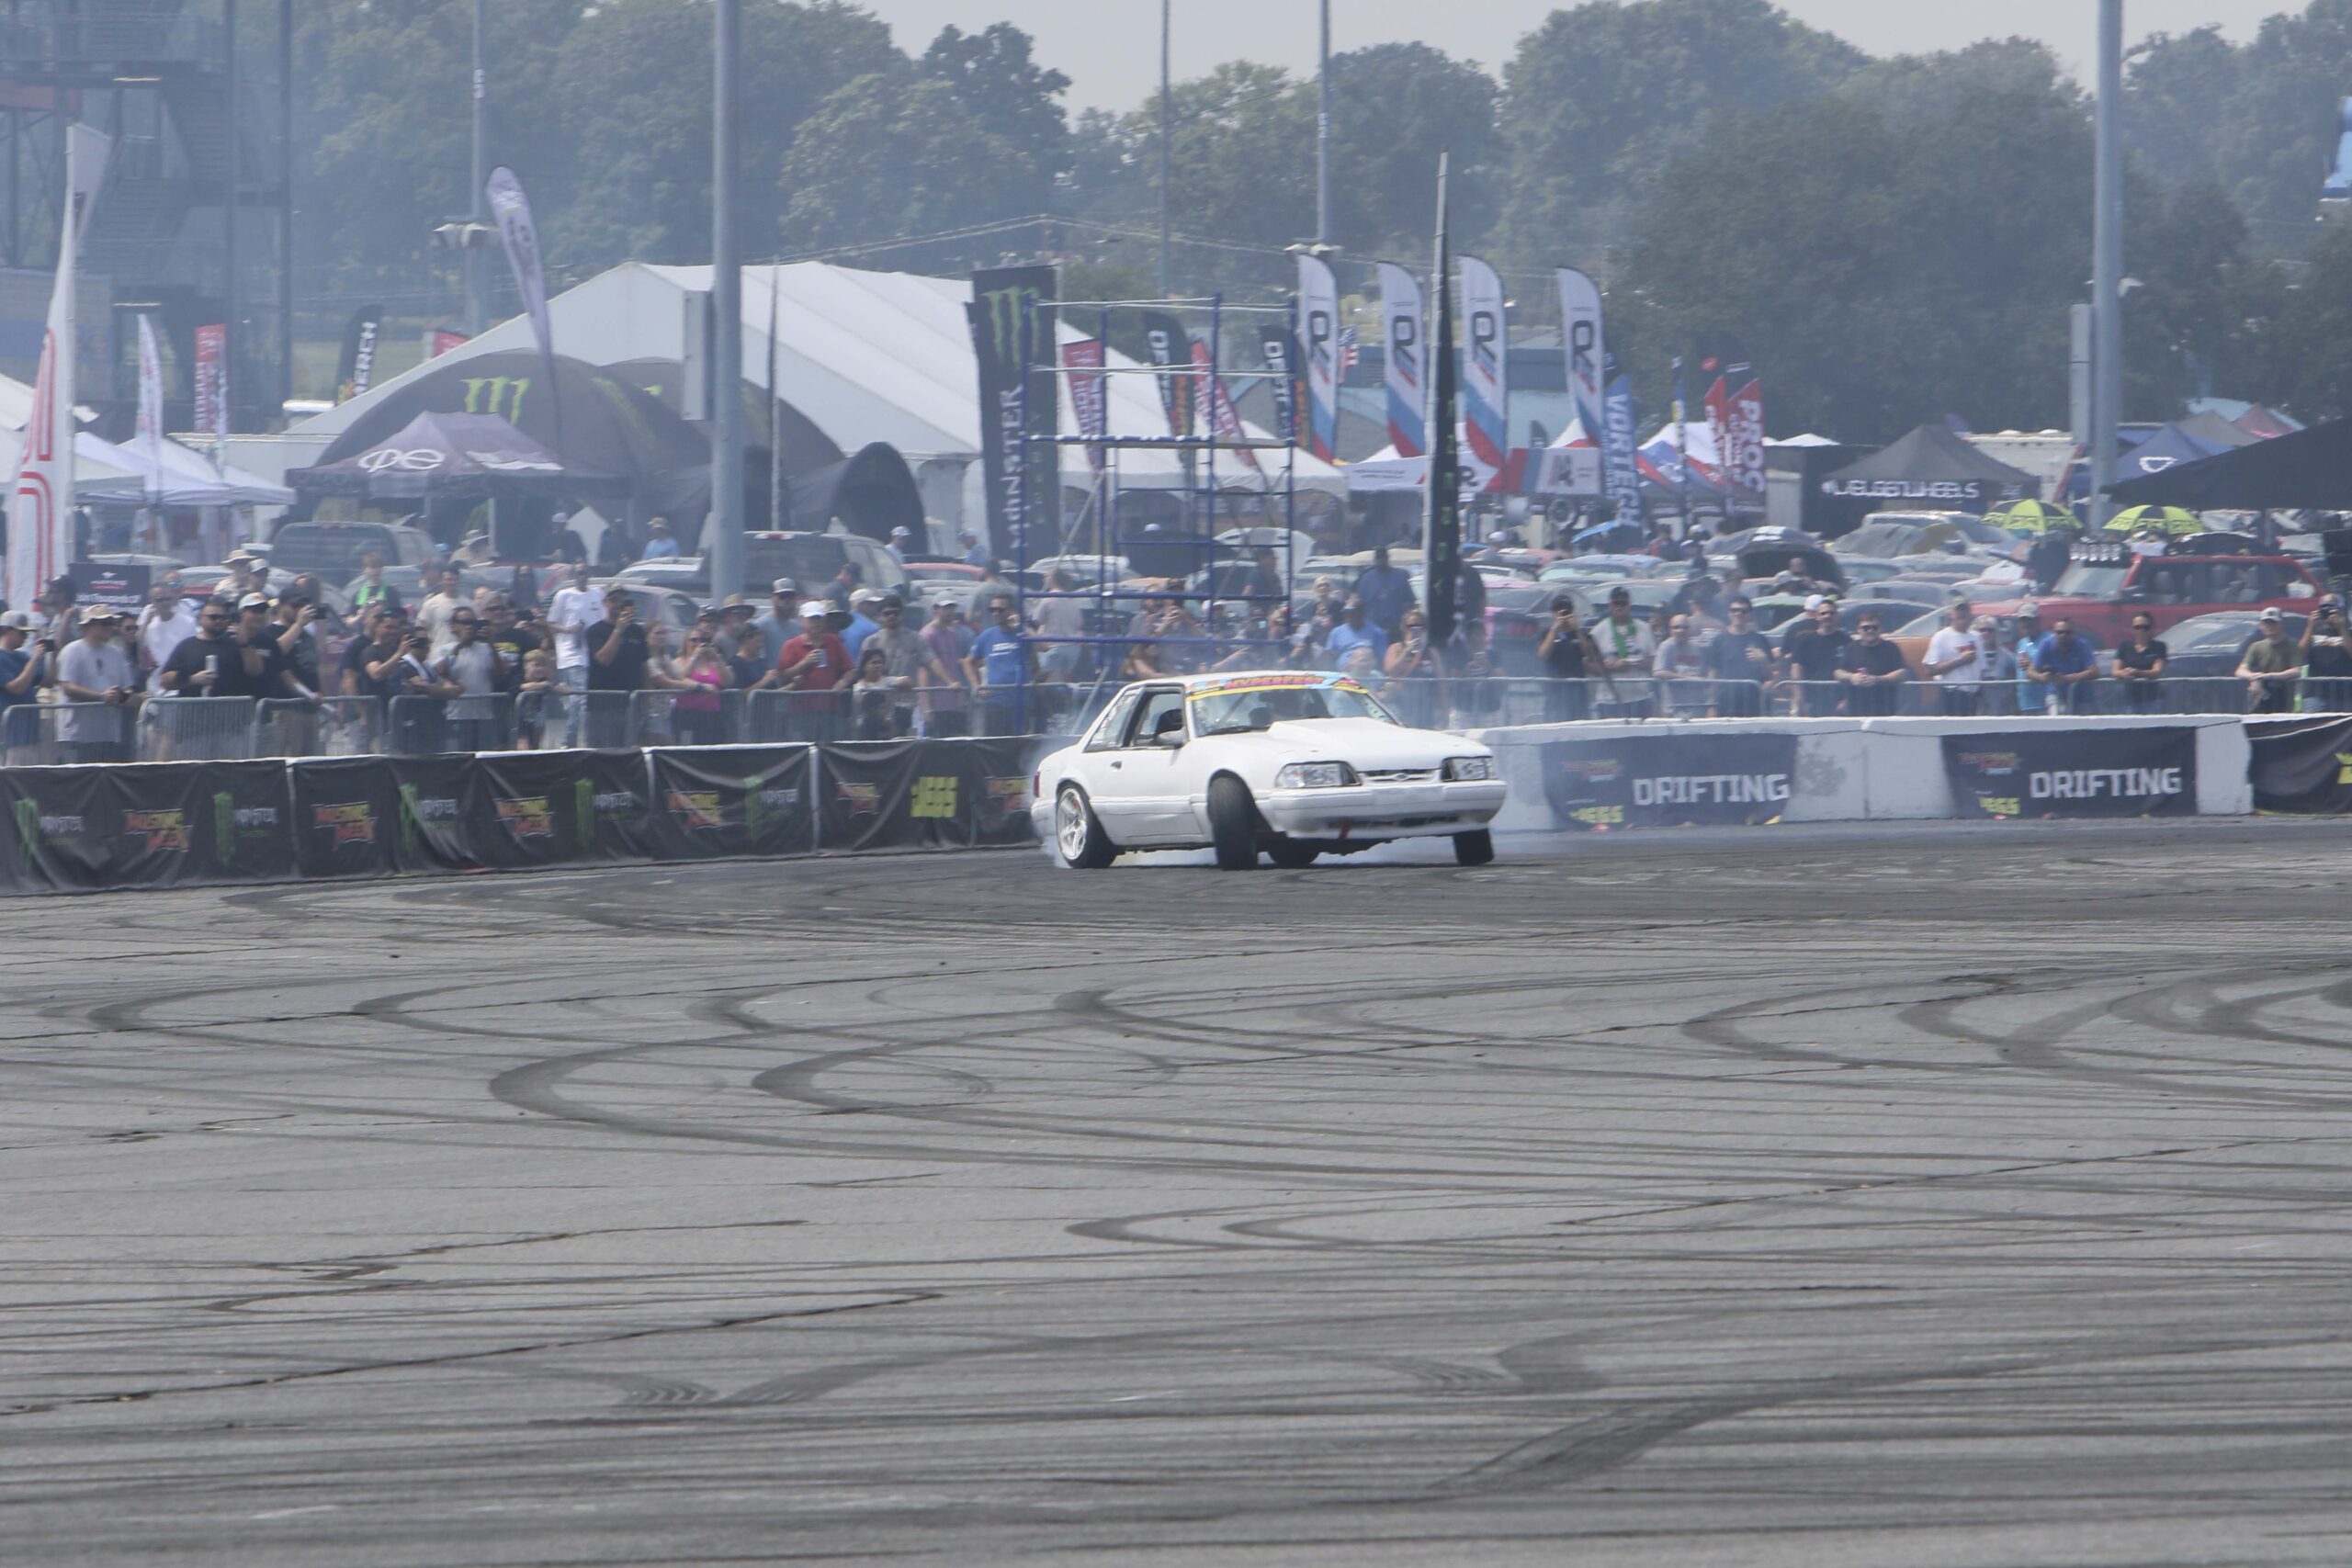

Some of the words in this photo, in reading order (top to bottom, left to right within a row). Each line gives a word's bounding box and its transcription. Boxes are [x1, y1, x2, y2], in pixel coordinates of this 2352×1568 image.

[1606, 392, 1642, 526] VORTECH
[1633, 773, 1791, 806] DRIFTING
[2029, 767, 2182, 798] DRIFTING
